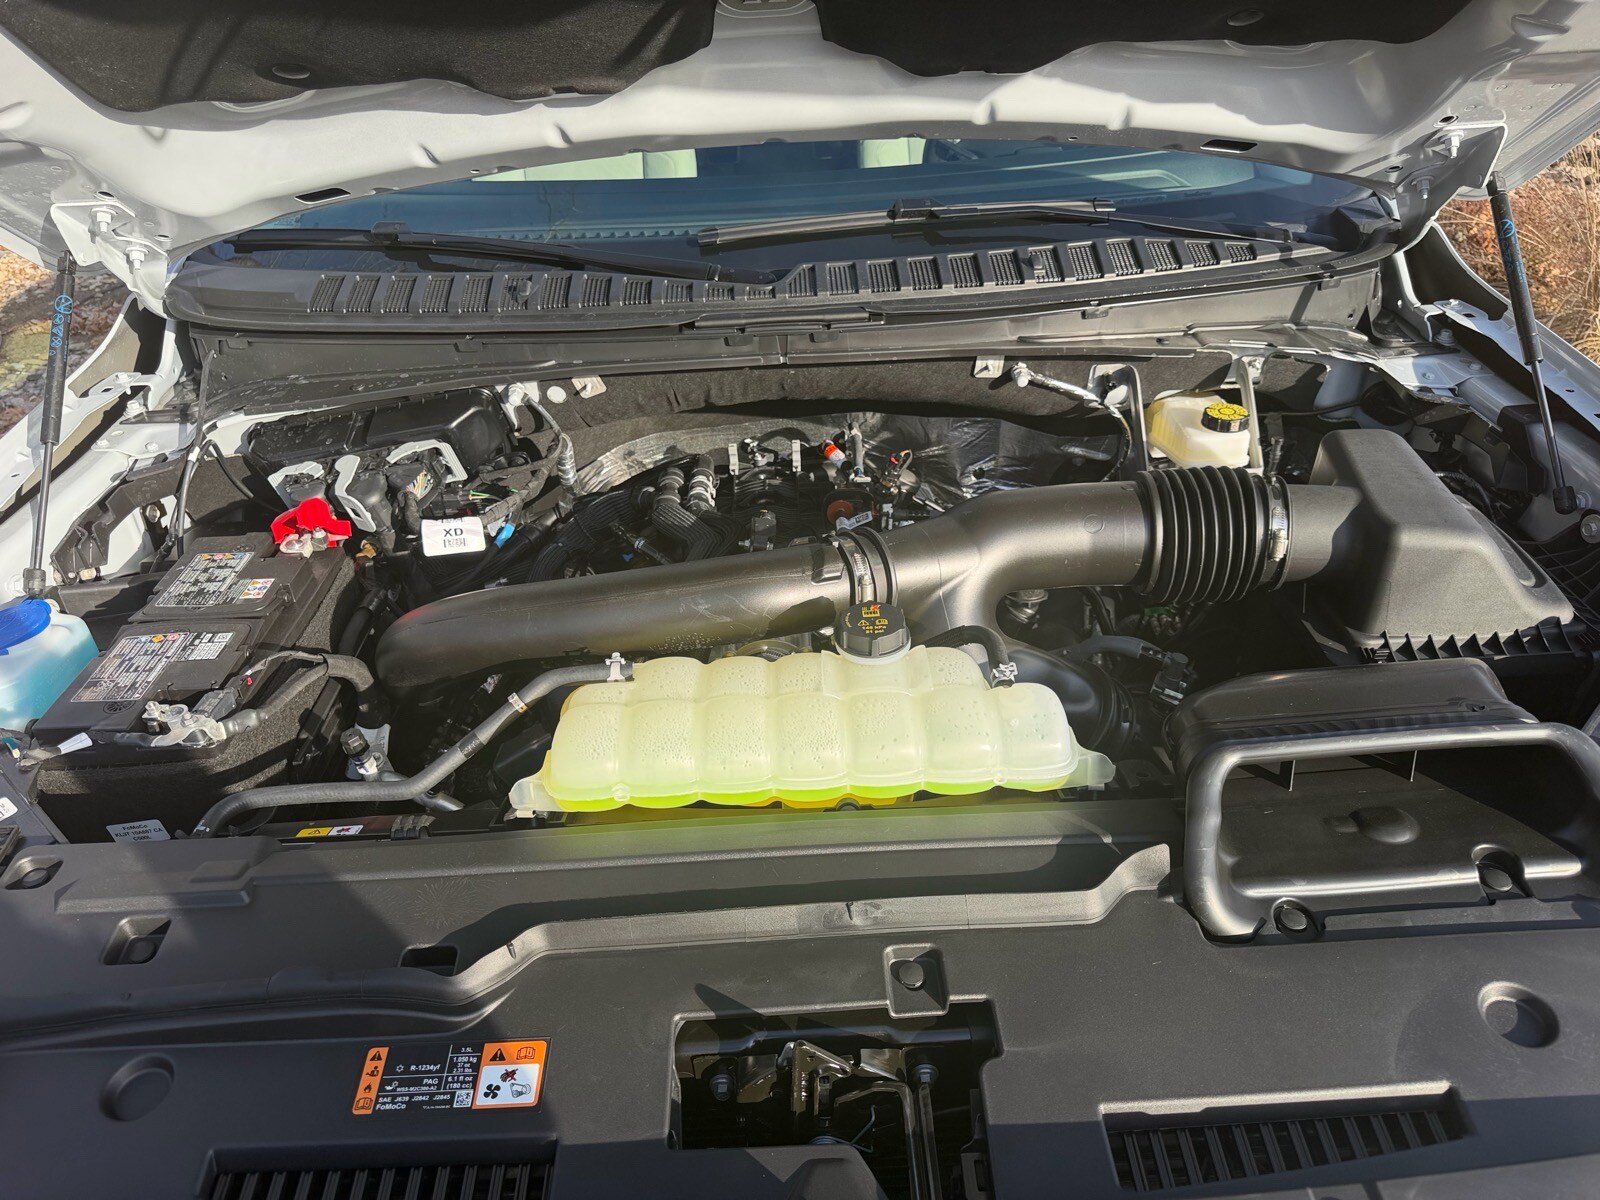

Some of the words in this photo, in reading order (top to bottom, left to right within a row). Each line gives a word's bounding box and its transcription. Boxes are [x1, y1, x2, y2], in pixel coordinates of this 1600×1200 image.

[443, 527, 464, 537] XD
[410, 1064, 441, 1072] R-1234yf
[446, 1082, 460, 1090] (180
[461, 1081, 473, 1089] cc)
